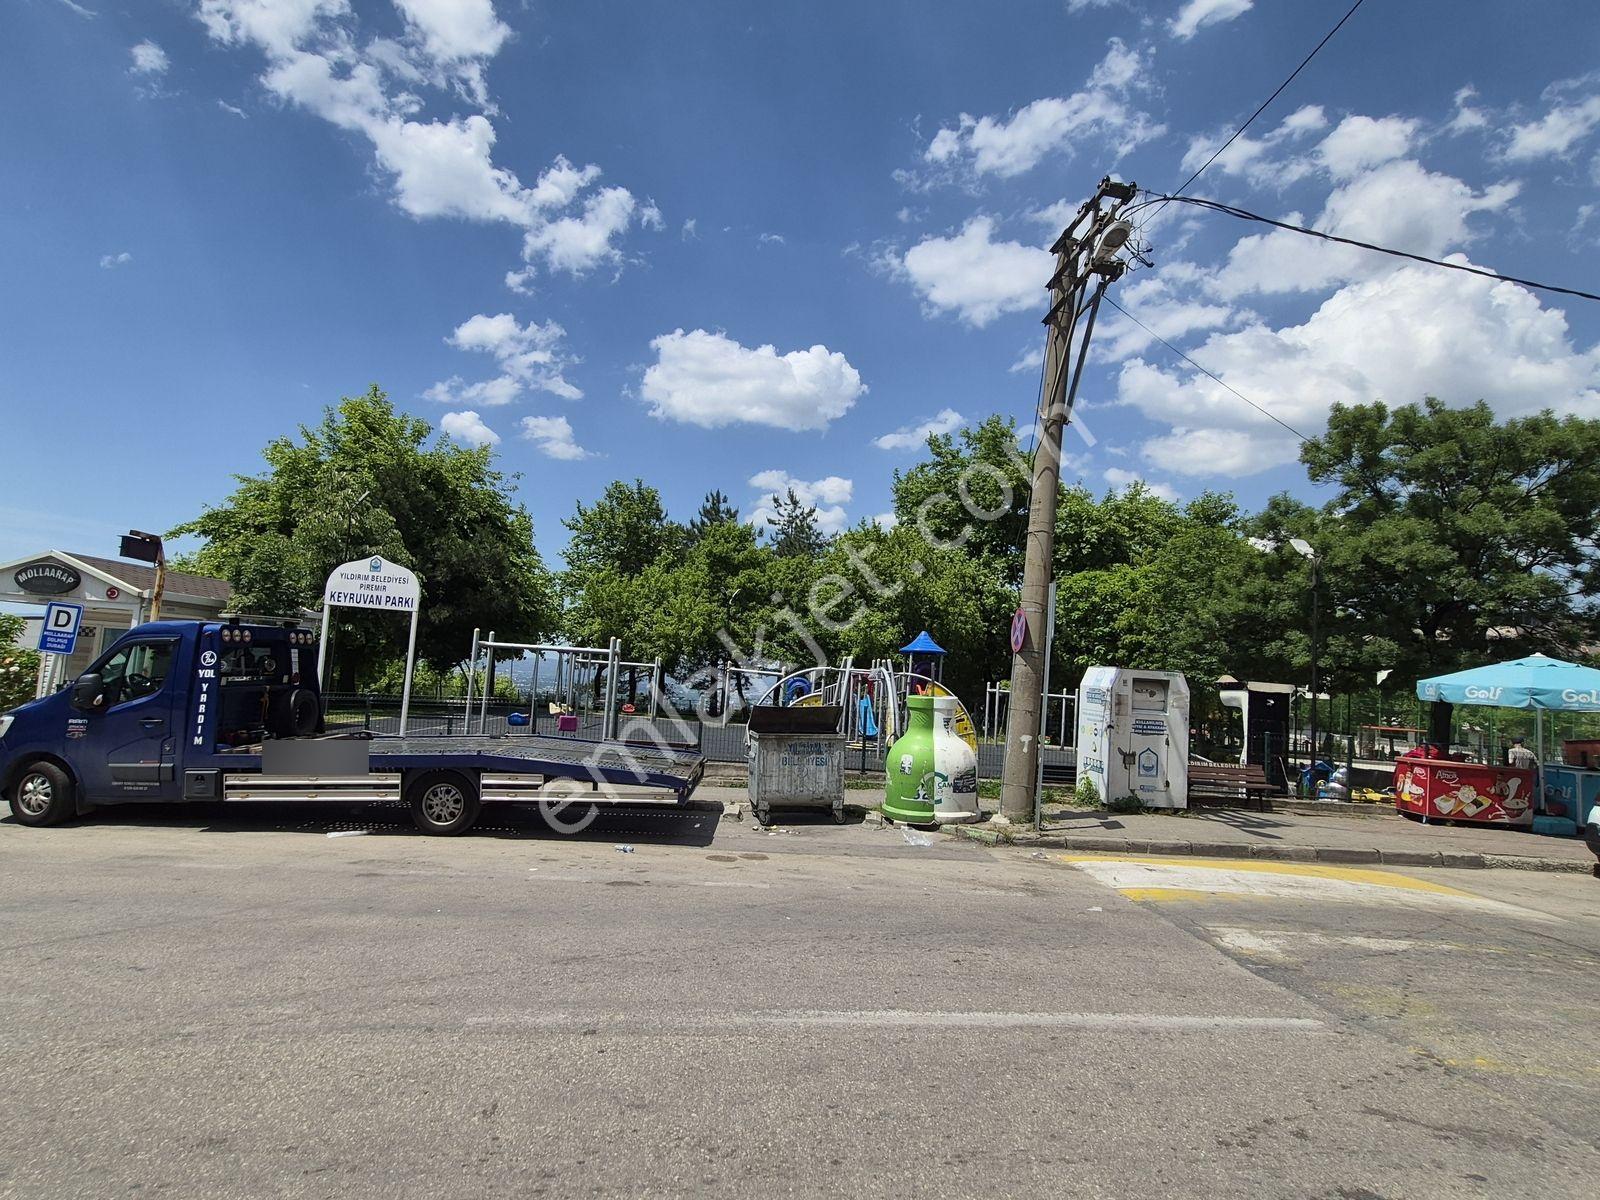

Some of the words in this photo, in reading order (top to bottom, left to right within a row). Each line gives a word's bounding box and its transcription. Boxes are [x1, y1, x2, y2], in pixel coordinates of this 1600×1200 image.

[18, 568, 74, 583] MOLLAARAP
[340, 573, 370, 581] YILDIRIM
[371, 574, 409, 585] BELEDİYESİ
[329, 591, 382, 606] KEYRUVAN
[385, 596, 414, 608] PARKI
[54, 610, 72, 627] D
[198, 669, 215, 678] YOL
[1465, 685, 1504, 700] Golf
[1562, 688, 1600, 704] Gol
[193, 683, 209, 745] YARDIM
